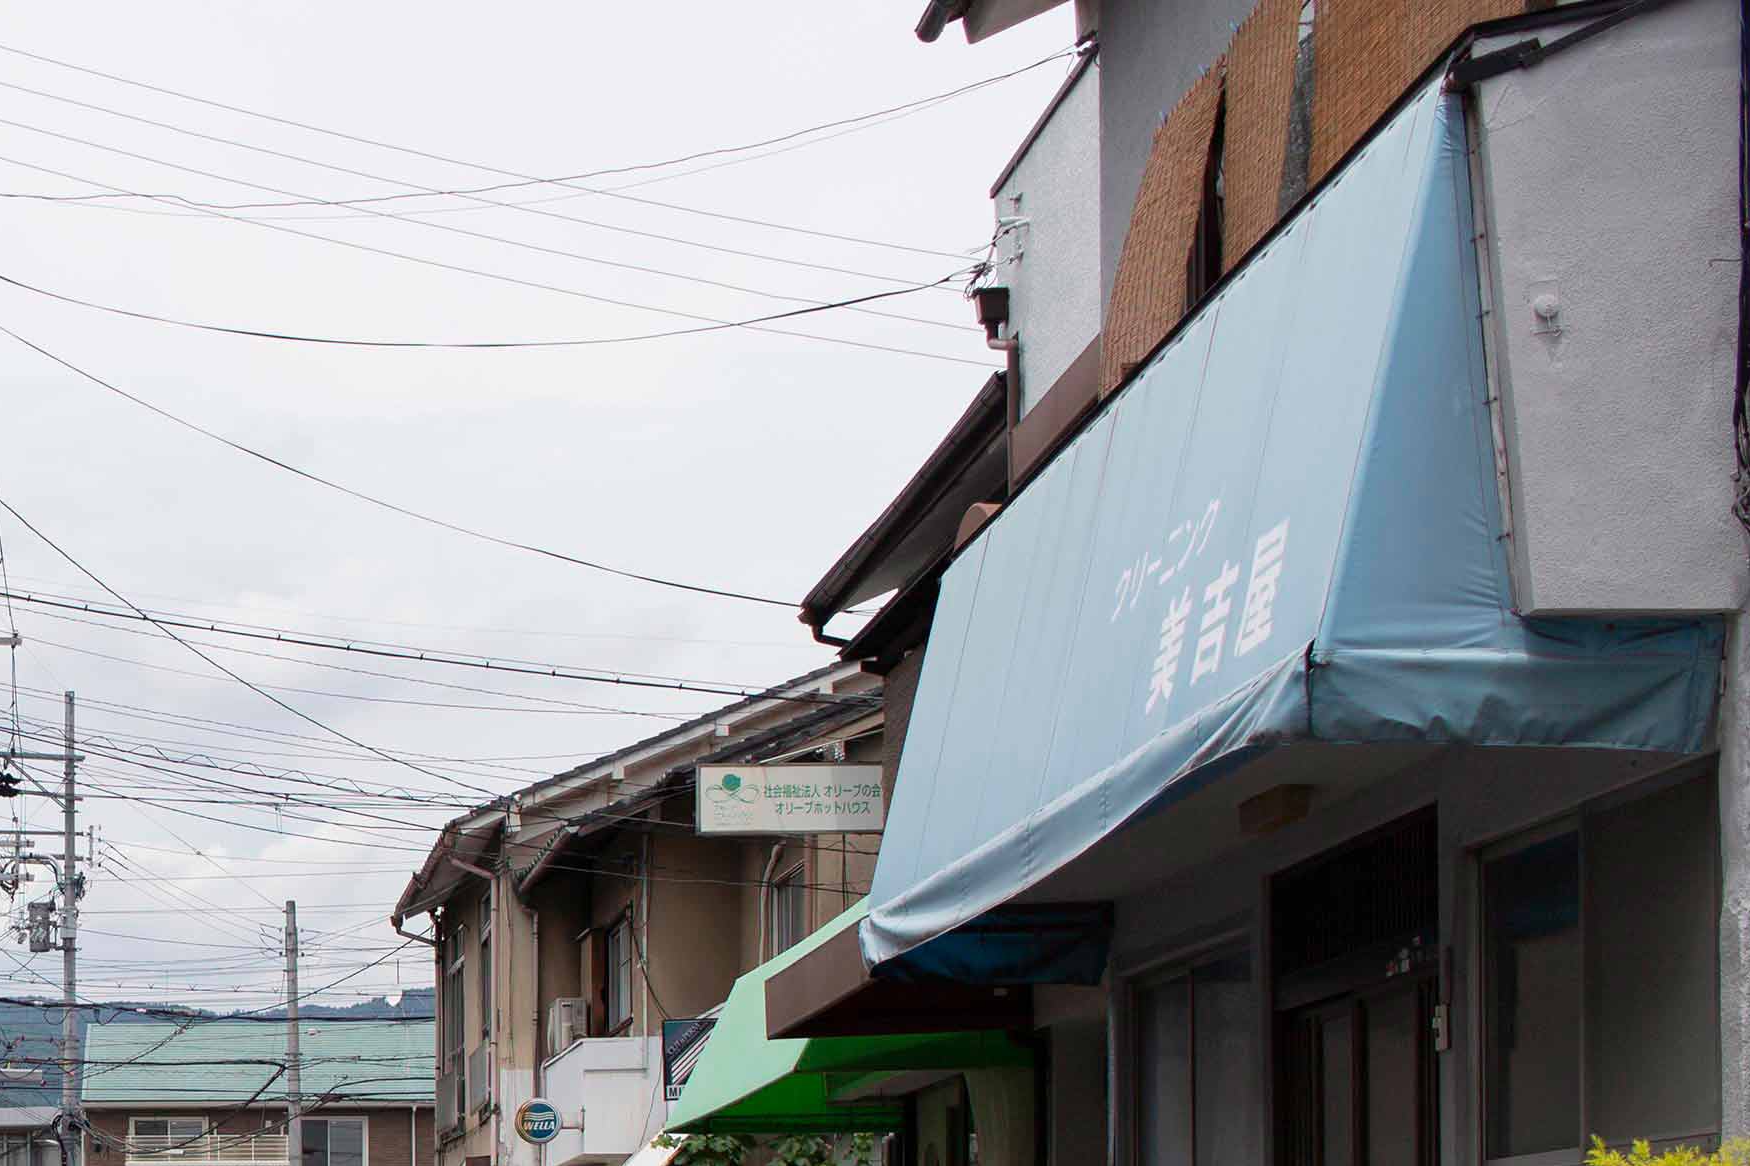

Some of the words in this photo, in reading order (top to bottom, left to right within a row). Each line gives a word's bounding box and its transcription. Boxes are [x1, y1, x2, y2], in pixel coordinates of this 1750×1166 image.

[1146, 518, 1290, 715] 美吉屋
[523, 1121, 555, 1131] WELLA
